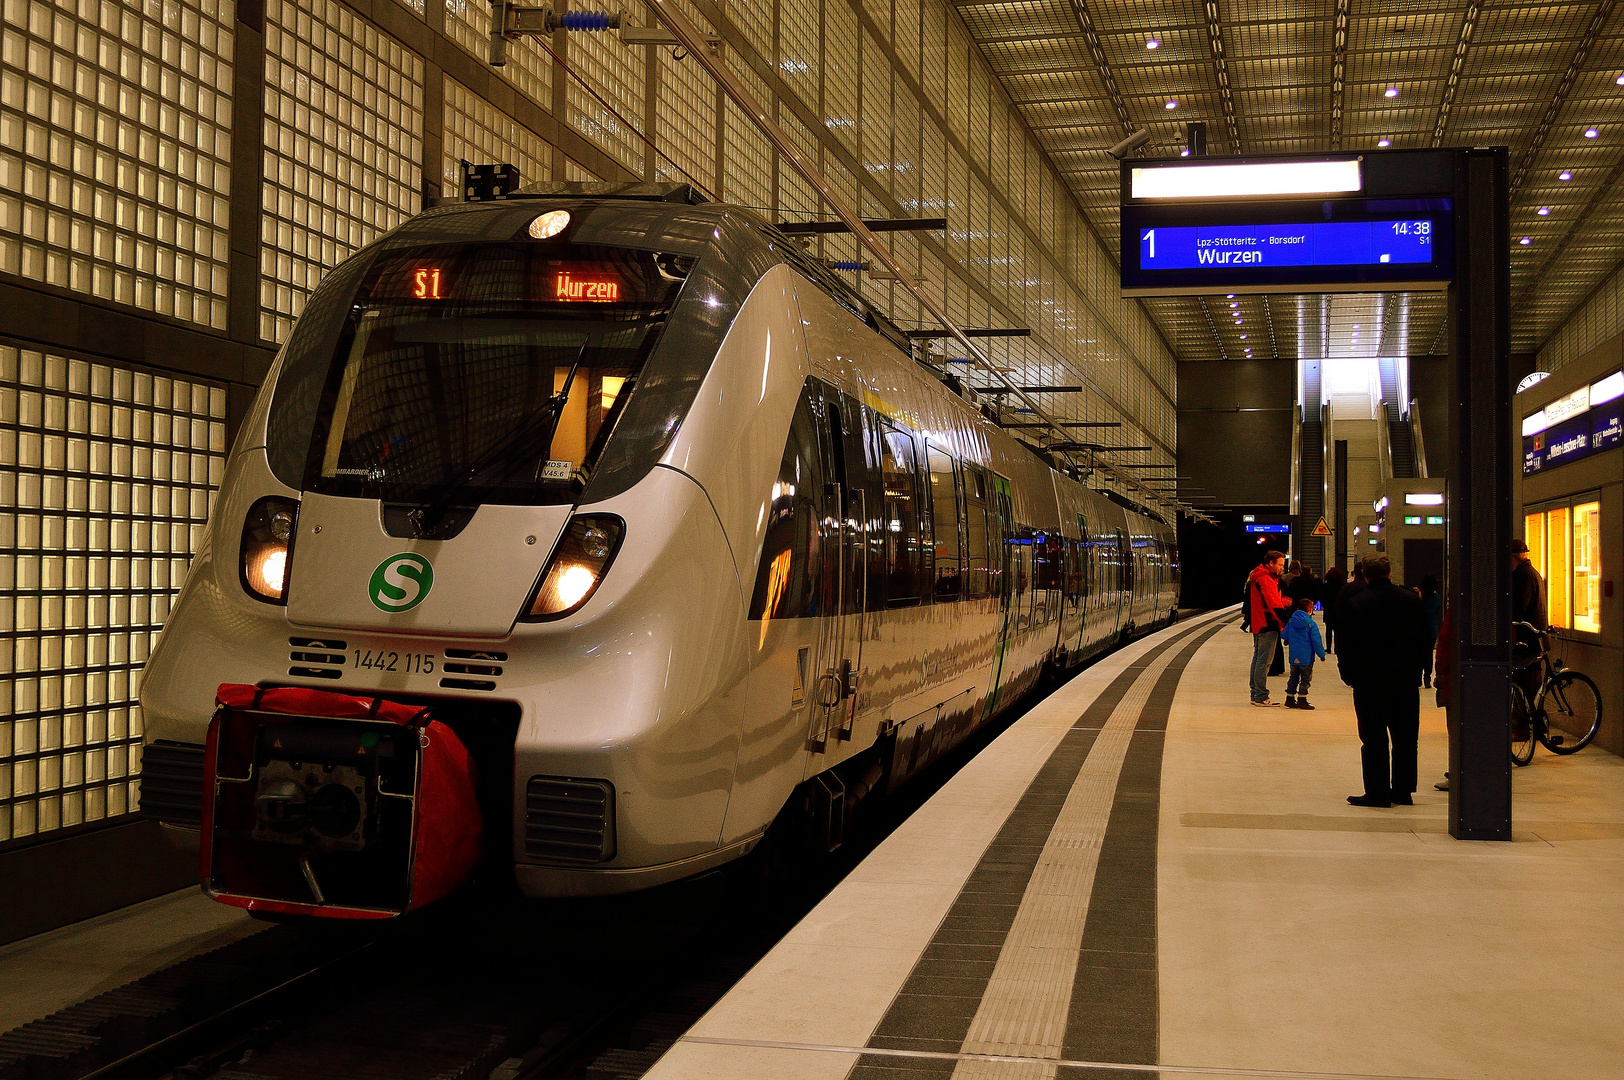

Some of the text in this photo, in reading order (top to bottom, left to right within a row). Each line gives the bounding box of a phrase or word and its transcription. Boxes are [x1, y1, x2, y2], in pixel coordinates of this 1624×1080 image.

[1197, 236, 1257, 247] Lpz-Stötteritz
[1269, 235, 1305, 245] Borsdorf
[1391, 222, 1430, 236] 14:38
[1419, 236, 1430, 245] S1
[1142, 229, 1155, 258] 1
[1197, 249, 1262, 264] Wurzen
[415, 268, 440, 300] S1
[556, 273, 617, 300] Wurzen
[377, 559, 424, 607] S
[354, 649, 435, 674] 1442 115
